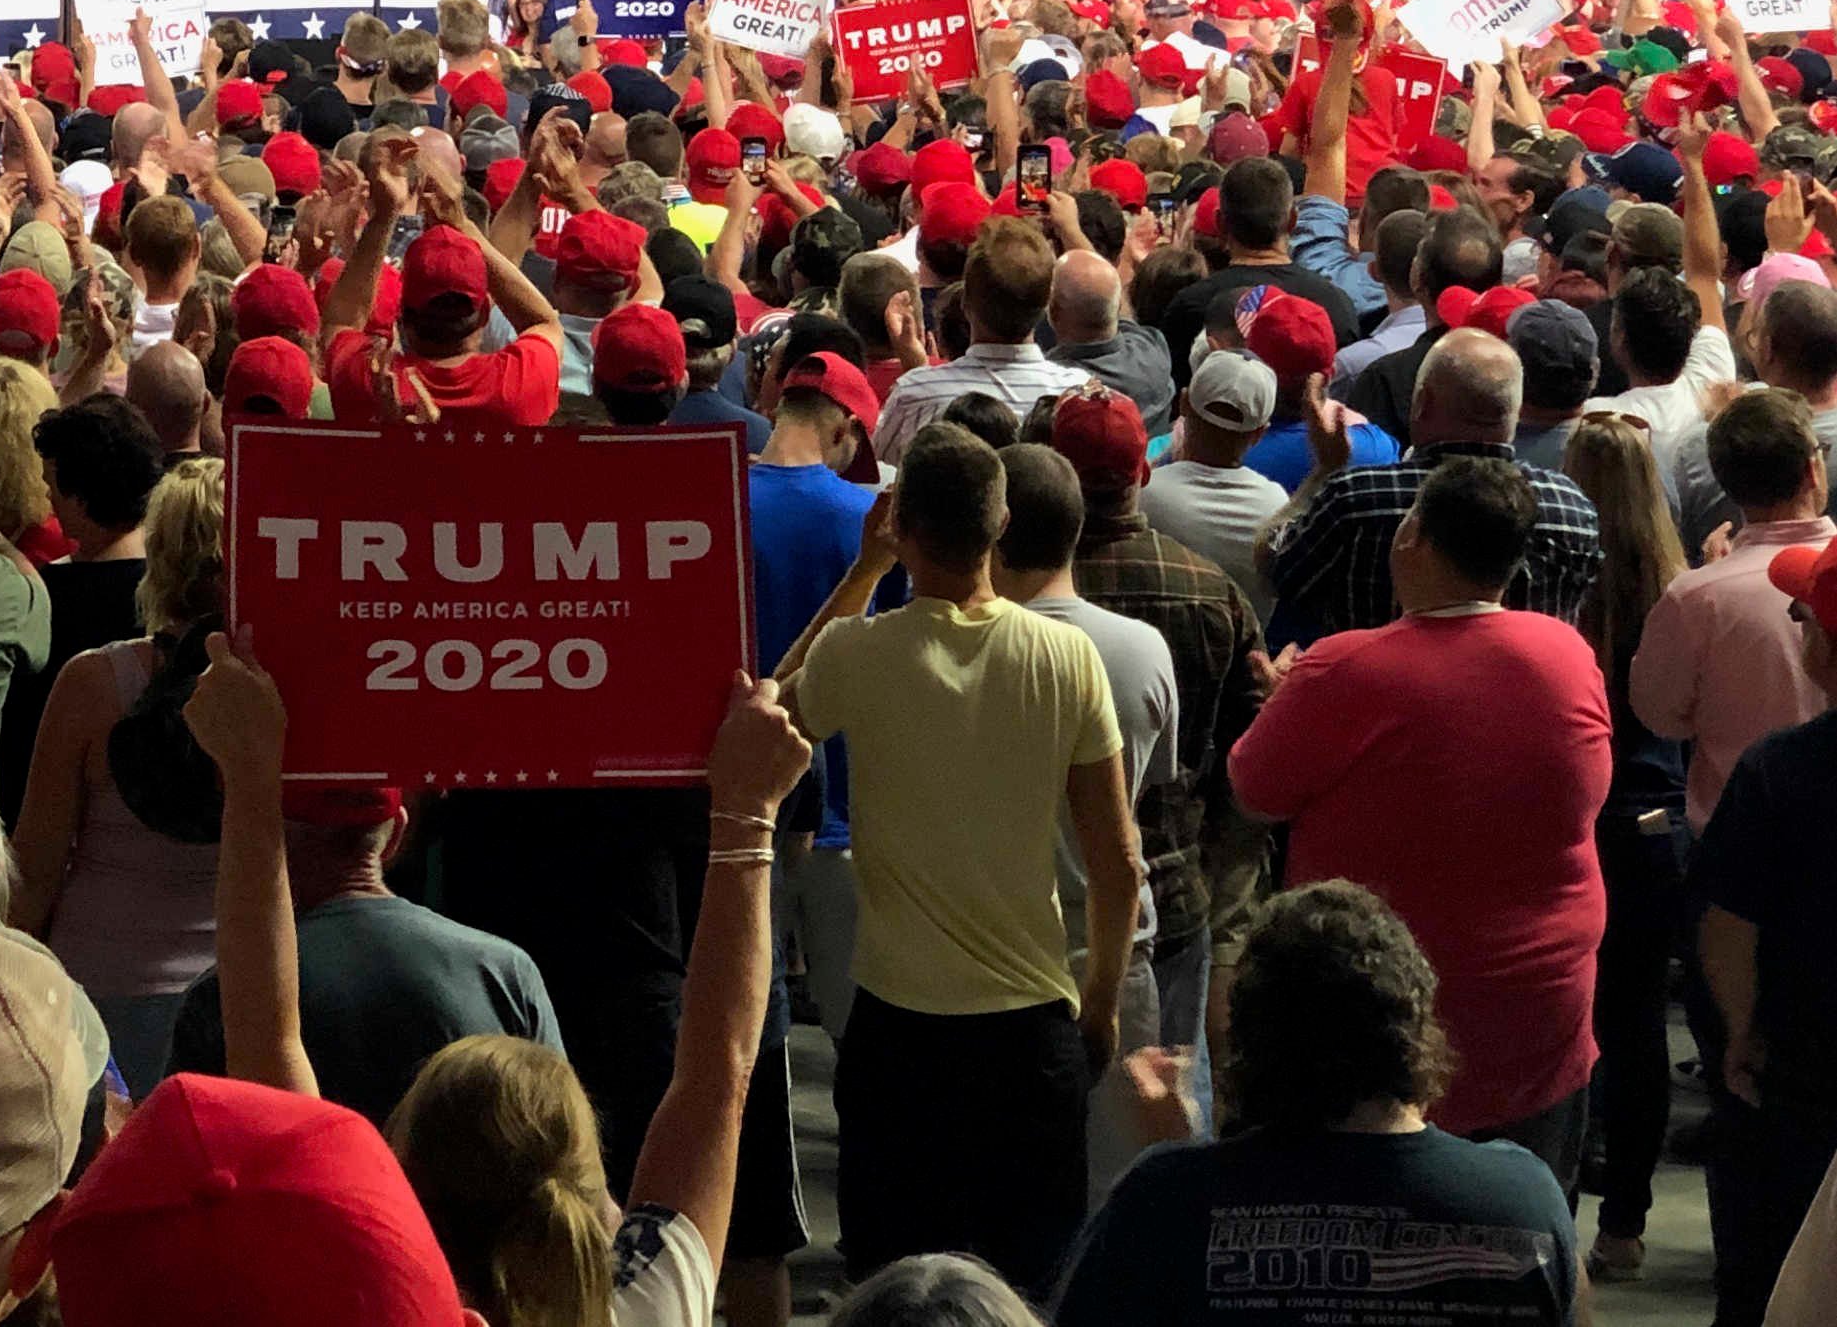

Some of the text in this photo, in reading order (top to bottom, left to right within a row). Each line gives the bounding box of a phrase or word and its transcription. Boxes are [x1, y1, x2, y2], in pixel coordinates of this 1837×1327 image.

[615, 1, 675, 17] 2020
[93, 19, 200, 46] AMICA
[732, 13, 805, 45] GREAT!
[844, 15, 966, 49] TRUMP
[110, 46, 187, 69] GRAT!
[257, 517, 713, 583] TRUMP
[339, 600, 631, 619] KEEP AMERICA GREAT!
[365, 638, 609, 692] 2020
[1206, 1246, 1373, 1292] 2010
